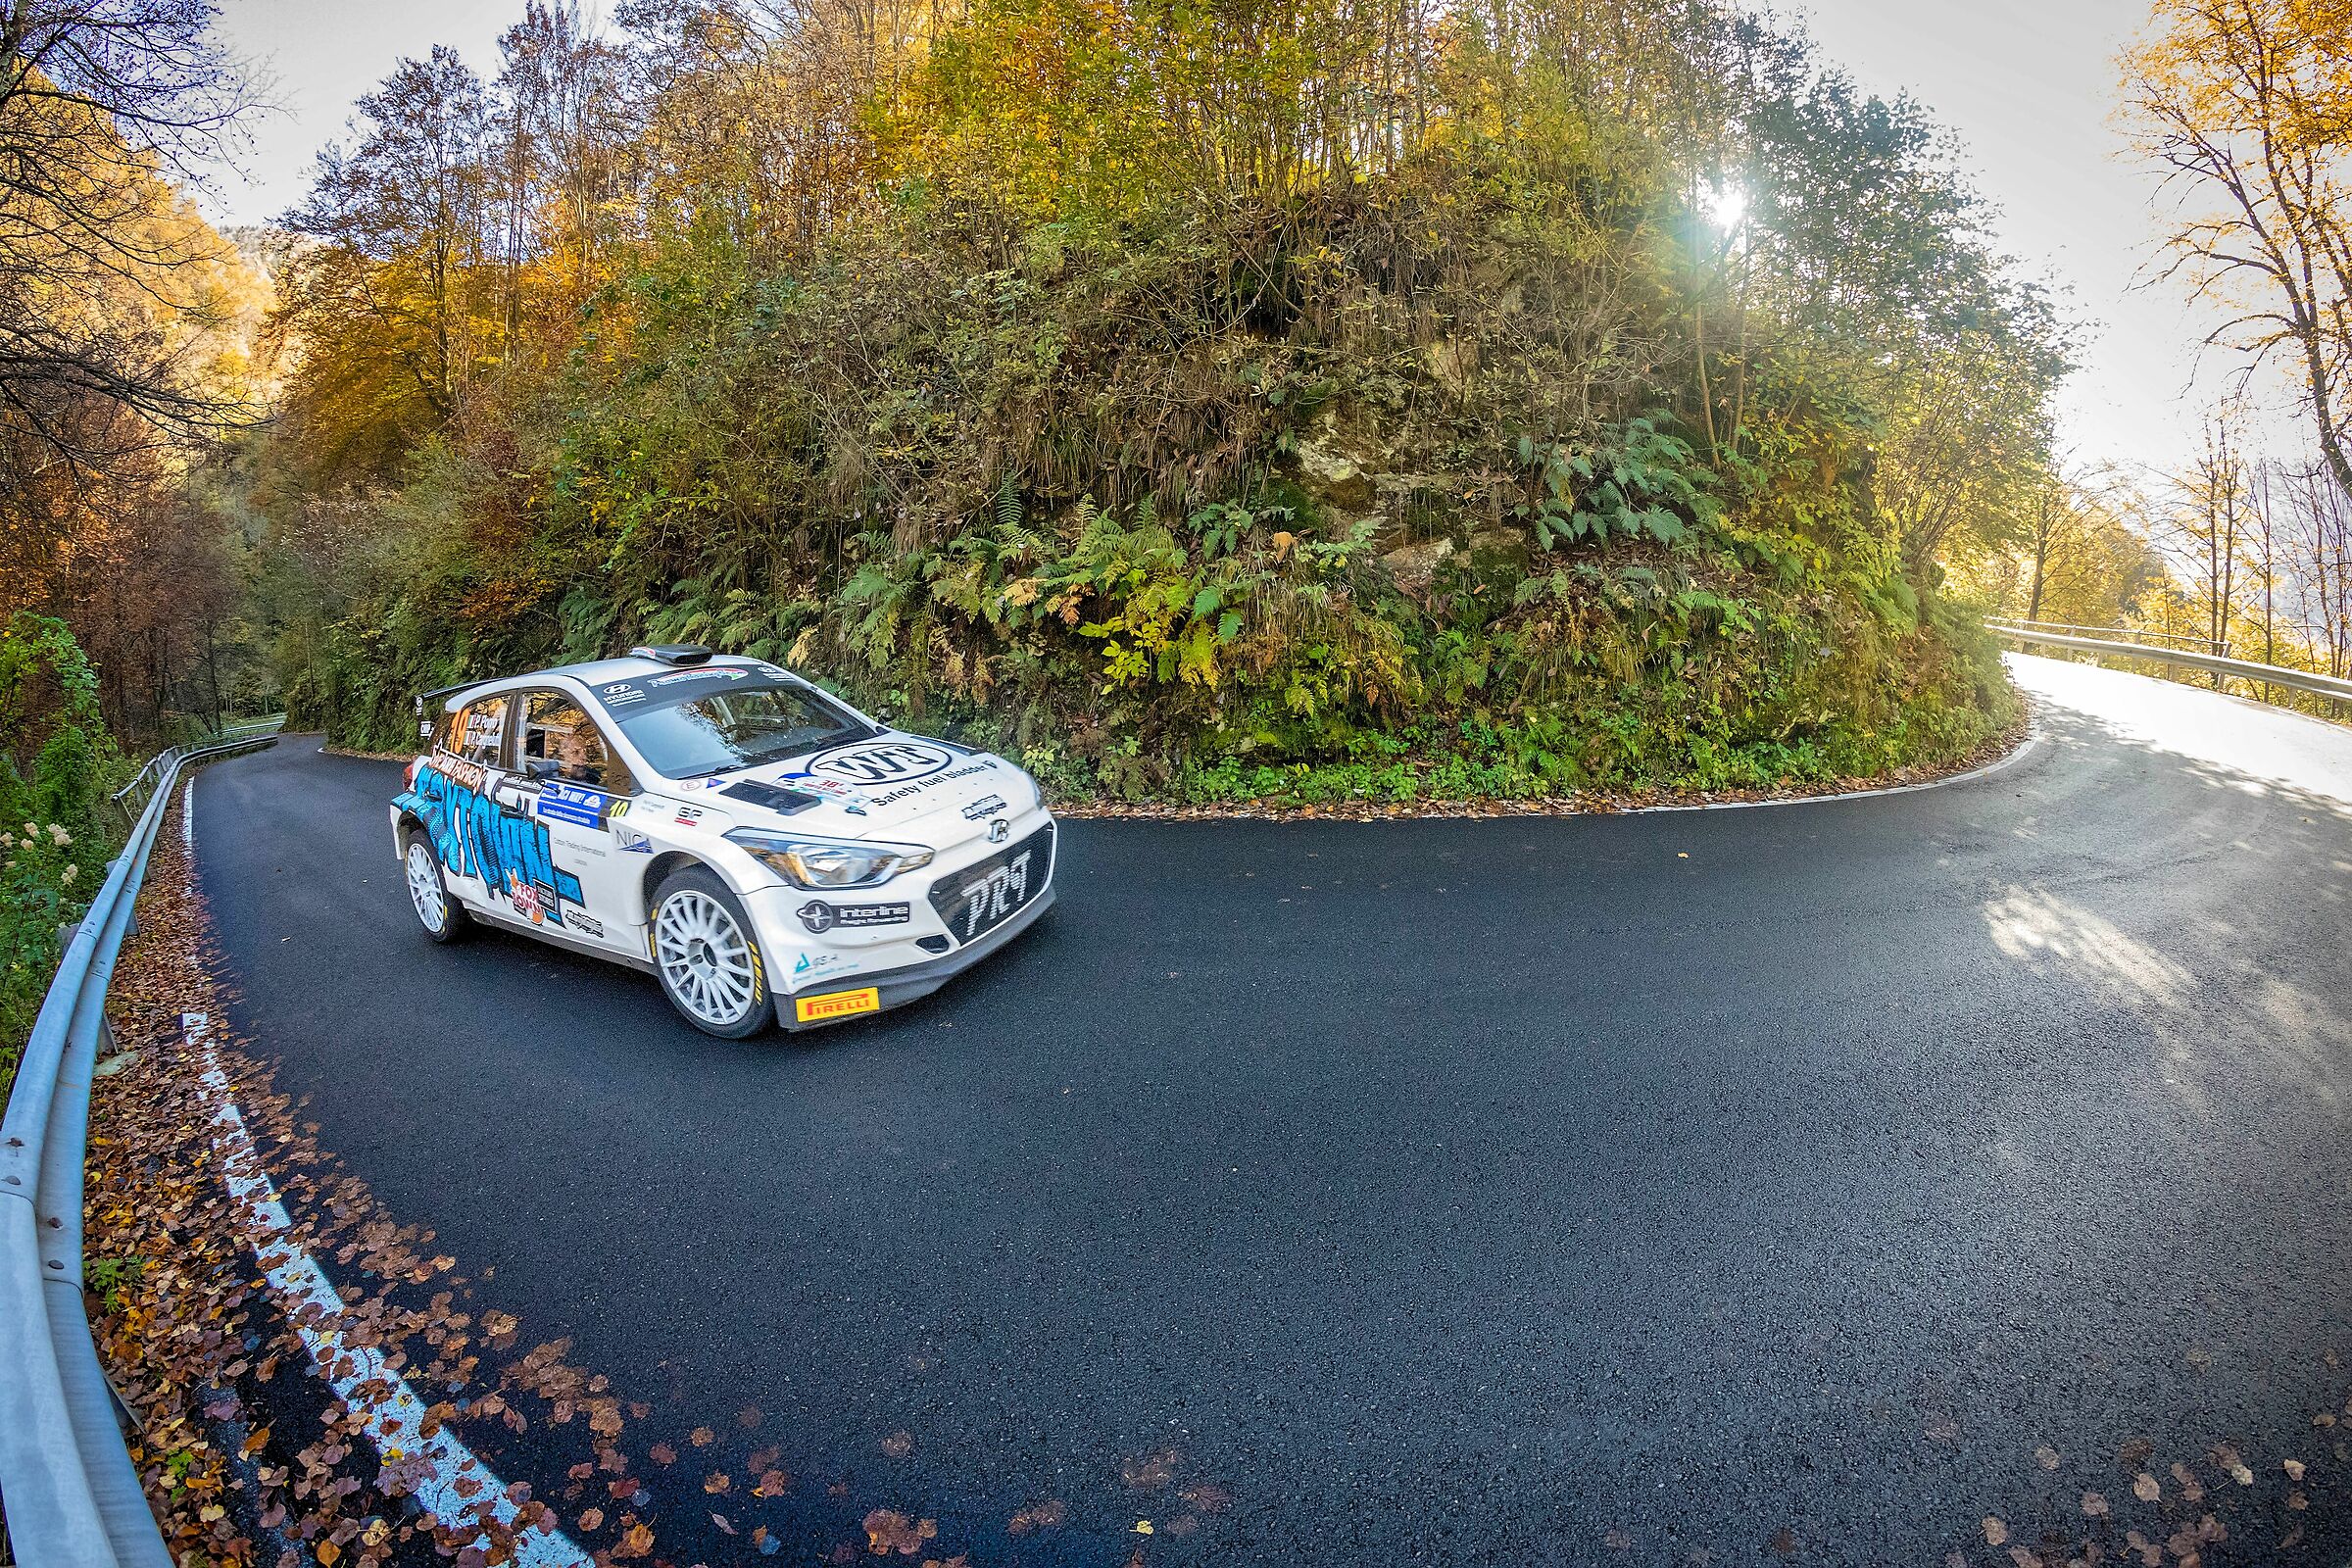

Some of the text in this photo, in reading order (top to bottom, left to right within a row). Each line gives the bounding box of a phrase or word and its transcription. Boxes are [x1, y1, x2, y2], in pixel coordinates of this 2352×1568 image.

[870, 784, 919, 807] Safety
[920, 775, 948, 794] fuel
[948, 764, 988, 780] bladder
[519, 883, 539, 902] FOX
[840, 906, 909, 918] interline
[806, 993, 870, 1016] PIRELLI
